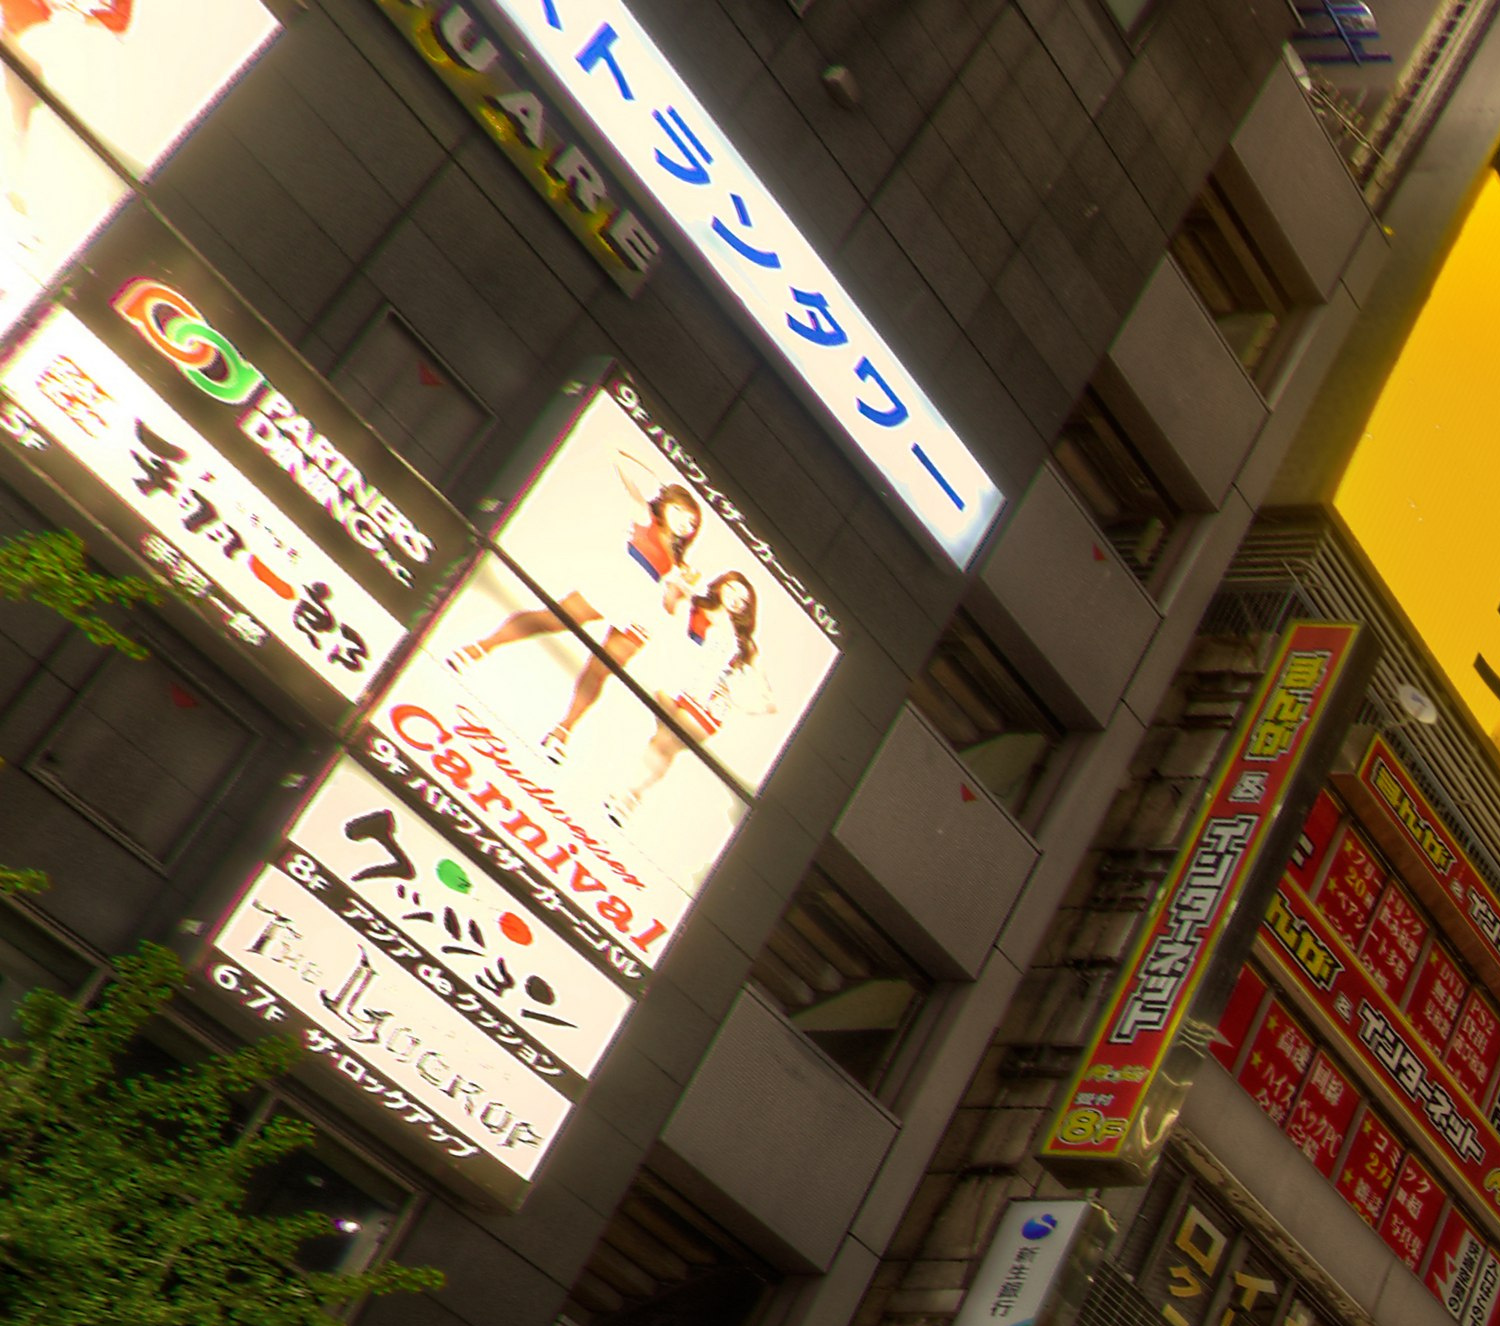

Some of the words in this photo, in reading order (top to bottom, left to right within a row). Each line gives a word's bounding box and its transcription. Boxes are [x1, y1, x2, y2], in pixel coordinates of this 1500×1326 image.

[537, 0, 969, 514] トランタワー
[236, 405, 387, 551] DINING
[258, 389, 437, 564] PARTNERS
[284, 852, 333, 893] 8F
[388, 702, 669, 955] Carnival
[1110, 813, 1259, 1045] インターネット
[1058, 1108, 1127, 1146] 8F
[1357, 998, 1486, 1165] インターネット
